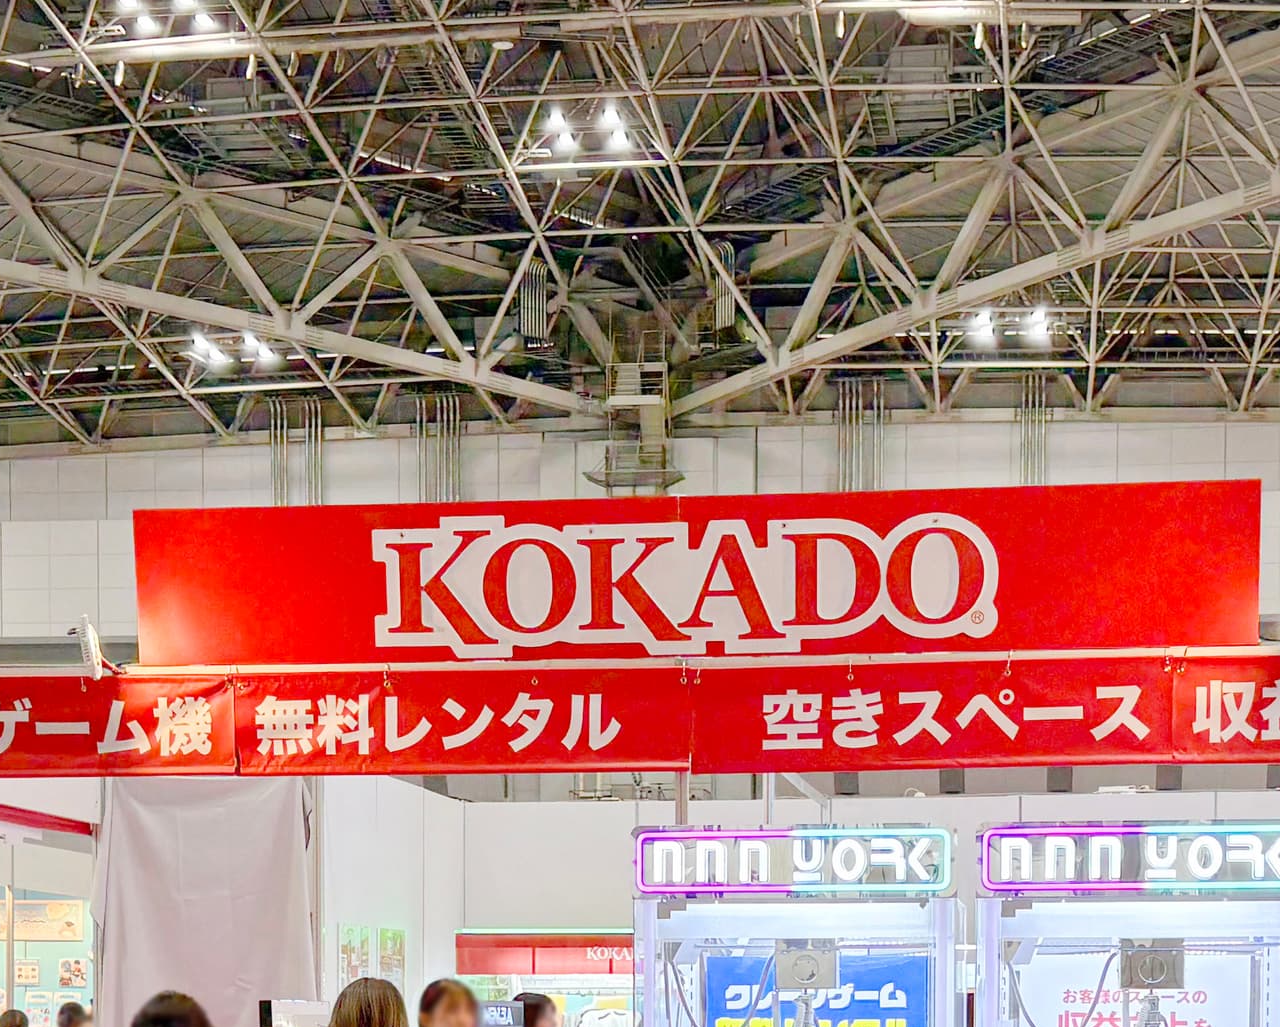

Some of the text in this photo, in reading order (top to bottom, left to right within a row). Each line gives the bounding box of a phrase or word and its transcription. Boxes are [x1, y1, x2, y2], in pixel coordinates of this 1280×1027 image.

[384, 526, 986, 646] KOKADO
[254, 694, 622, 757] 無料レンタル
[762, 685, 1152, 751] 空きスペース
[586, 946, 634, 960] KOKA
[1062, 989, 1208, 1005] お客様のスースの
